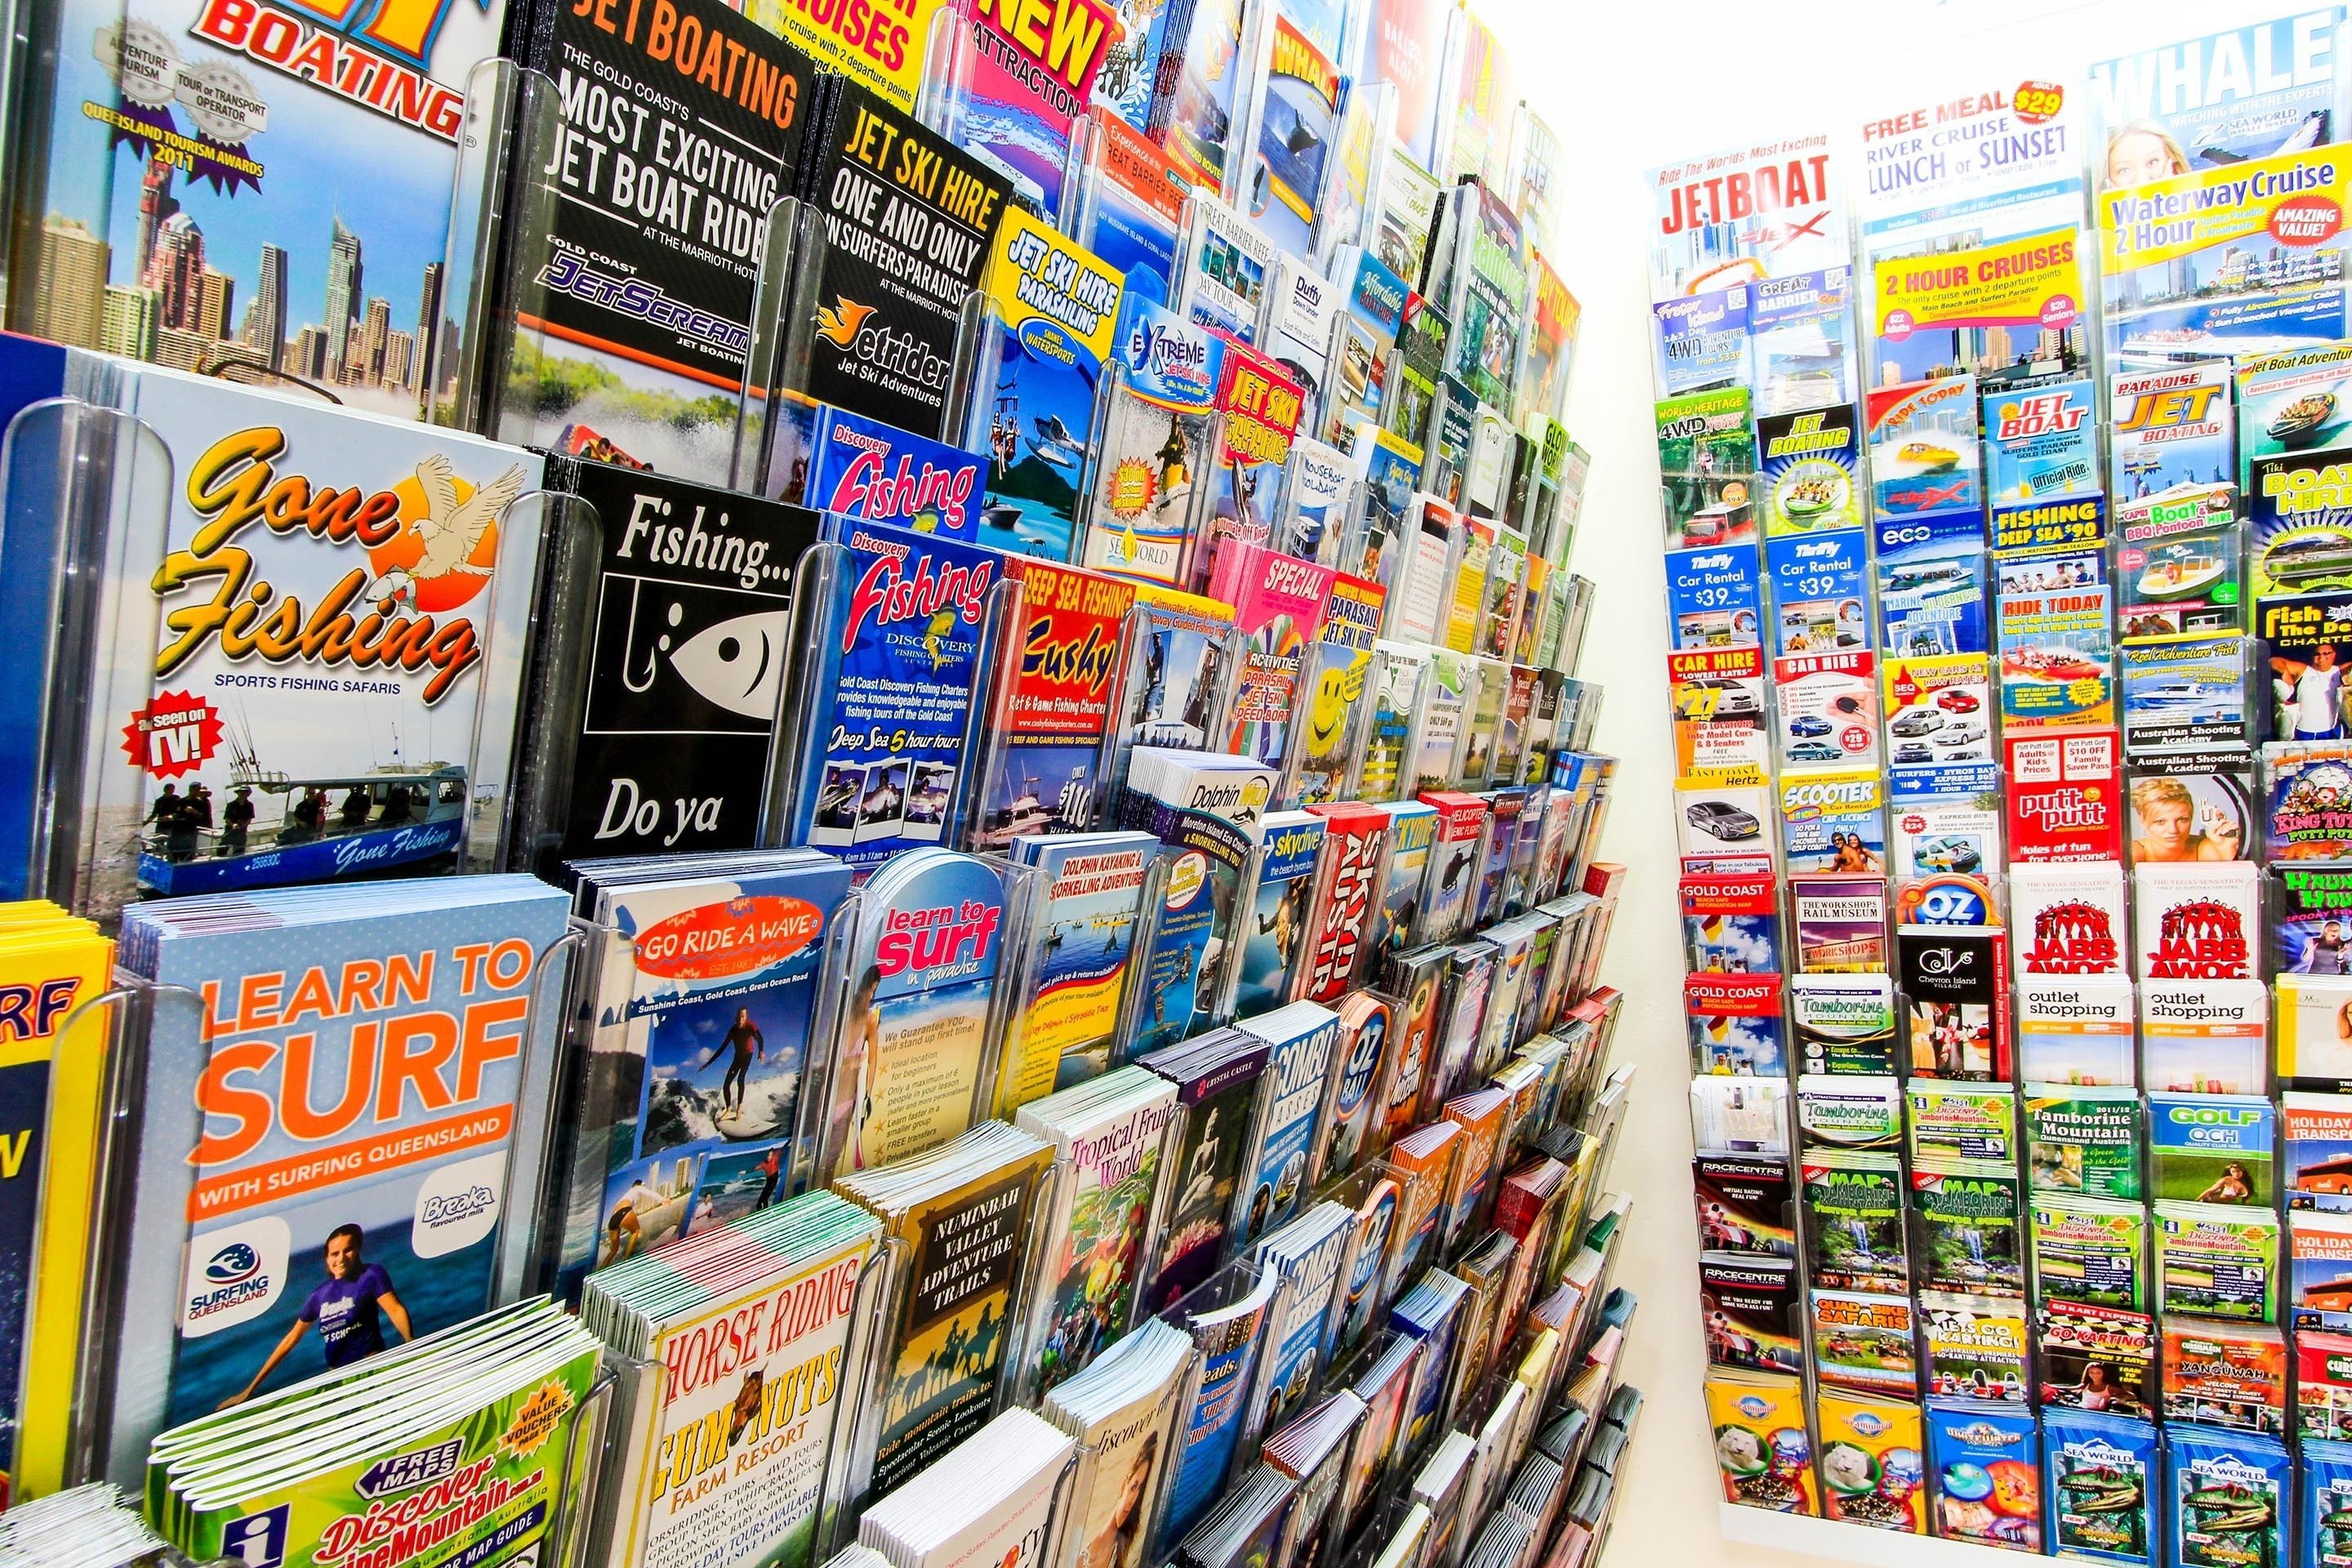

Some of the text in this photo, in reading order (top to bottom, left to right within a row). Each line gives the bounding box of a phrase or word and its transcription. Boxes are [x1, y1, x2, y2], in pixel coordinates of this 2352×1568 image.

[198, 0, 466, 139] BOATING
[563, 42, 689, 121] THE GOLD COAST'S
[647, 0, 798, 130] BOATING
[789, 19, 912, 103] cruise with 2 departure points
[973, 21, 1081, 118] ATTRACTION
[2098, 11, 2333, 123] WHALE
[177, 74, 265, 118] TOUR or TRANSPORT
[196, 96, 246, 122] OPERATOR
[1863, 89, 2009, 143] FREE MEAL
[2015, 88, 2061, 115] $29
[154, 143, 194, 172] 2011
[163, 130, 264, 178] TOURISM AWARDS
[559, 67, 777, 214] MOST EXCITING
[1658, 135, 1827, 187] Ride The Worlds Most Exciting
[1866, 117, 2010, 164] RIVER CRUISE
[1869, 125, 2066, 195] LUNCH or SUNSET
[544, 122, 698, 234] JET BOAT
[845, 108, 1000, 233] JET SKI HIRE
[1661, 154, 1829, 235] JETBOAT
[2111, 164, 2334, 226] Waterway Cruise
[2274, 208, 2336, 223] AMAZING
[830, 167, 982, 279] ONE AND ONLY
[2278, 221, 2326, 237] VALUE!
[1008, 228, 1119, 318] JET SKI HIRE
[1886, 241, 2074, 296] 2 HOUR CRUISES
[1017, 273, 1099, 337] PARASAILING
[1026, 333, 1076, 366] WATERSPORTS
[837, 358, 942, 408] Jet Ski Adventures
[1229, 366, 1301, 430] JET SKI
[2117, 373, 2200, 394] PARADISE
[1792, 413, 1824, 434] JET
[2117, 385, 2223, 430] JET
[833, 425, 892, 457] Discovery
[1224, 411, 1289, 467] SAFARIS
[1767, 429, 1849, 456] BOATING
[2143, 422, 2221, 443] BOATING
[187, 426, 403, 559] Gone
[830, 452, 977, 530] Fishing
[2033, 463, 2087, 488] Official Ride
[1998, 503, 2097, 530] FISHING
[1998, 523, 2097, 546] DEEP SEA $90
[617, 493, 791, 590] Fishing...
[851, 531, 910, 559] Discovery
[1264, 559, 1325, 602] SPECIAL
[1780, 557, 1851, 576] Car Rental
[1799, 577, 1834, 596] $39
[844, 554, 994, 654] Fishing
[1327, 594, 1379, 628] PARASAIL
[150, 546, 483, 707] Fishing
[215, 674, 401, 694] SPORTS FISHING SAFARIS
[1673, 652, 1755, 672] CAR HIRE
[1726, 776, 1759, 786] Hertz
[2137, 754, 2246, 766] Australian Shooting
[2165, 764, 2216, 773] Academy
[595, 777, 723, 847] Do ya
[1191, 784, 1241, 812] Dolphin
[1784, 781, 1874, 806] SCOOTER
[1684, 884, 1764, 897] GOLD COAST
[644, 914, 811, 960] GO RIDE A WAVE
[885, 899, 983, 933] learn to
[877, 906, 1000, 977] surf
[201, 937, 534, 1041] LEARN TO
[638, 972, 808, 1014] Sunshine Coast, Gold Coast, Great Ocean Road
[2029, 991, 2079, 1003] outlet
[2029, 1004, 2116, 1018] shopping
[184, 996, 528, 1167] SURF
[1205, 1062, 1253, 1089] CRYSTAL CASTLE
[1071, 1098, 1173, 1174] Tropical Fruit
[2034, 1107, 2131, 1125] Tamborine
[2042, 1123, 2131, 1138] Mountain
[2169, 1107, 2262, 1127] GOLF
[198, 1117, 501, 1209] WITH SURFING QUEENSLAND
[1098, 1138, 1146, 1190] World
[1703, 1163, 1784, 1175] RACECENTRE
[421, 1184, 497, 1225] Breaka
[934, 1186, 1021, 1243] NUMINBAH
[944, 1216, 1003, 1261] VALLEY
[918, 1233, 1015, 1298] ADVENTURE
[188, 1288, 269, 1321] QUEENSLAND
[189, 1274, 270, 1313] SURFING
[933, 1267, 991, 1313] TRAILS
[662, 1257, 860, 1409] HORSE RIDING
[1818, 1312, 1909, 1331] SAFARIS
[2181, 1361, 2265, 1380] YANGUWAH
[506, 1400, 569, 1446] VOUCHERS
[521, 1393, 558, 1424] VALUE
[382, 1458, 461, 1490] MAPS
[391, 1440, 461, 1475] FREE
[669, 1420, 809, 1516] FARM RESORT
[2065, 1447, 2133, 1463] SEA WORLD
[317, 1452, 497, 1559] Discover
